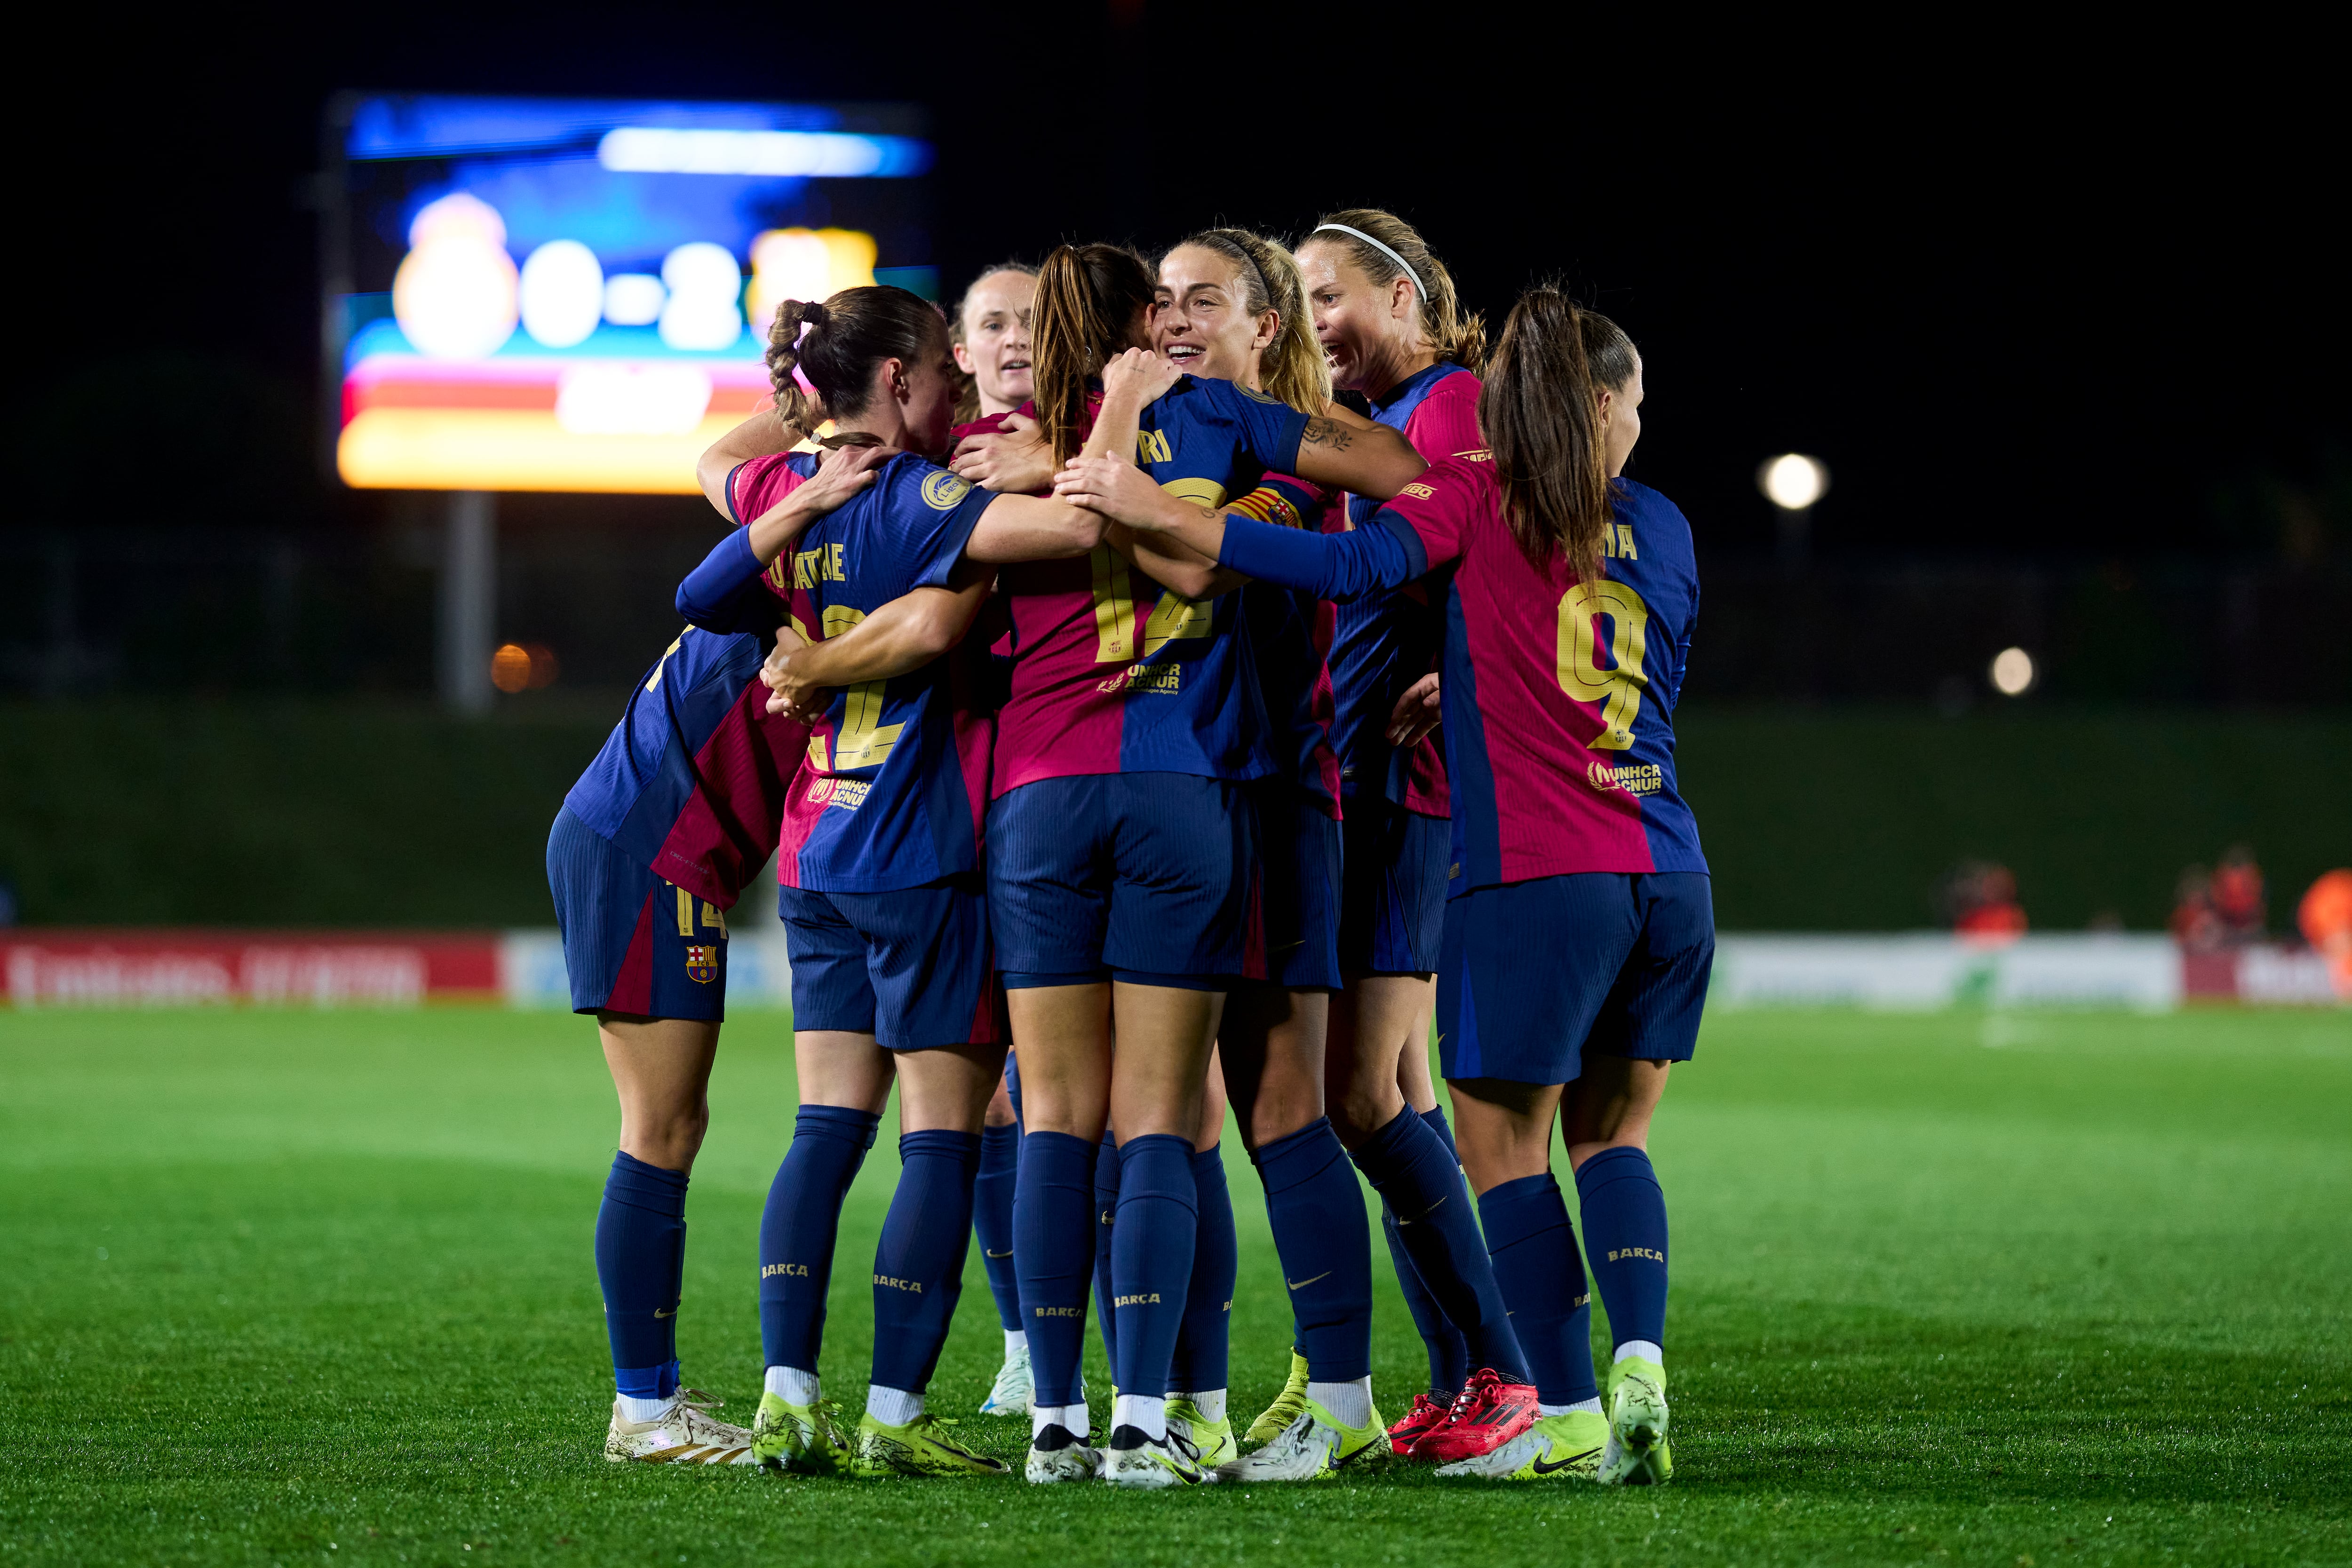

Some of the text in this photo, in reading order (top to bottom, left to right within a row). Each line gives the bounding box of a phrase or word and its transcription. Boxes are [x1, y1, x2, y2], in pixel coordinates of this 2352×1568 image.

[941, 483, 959, 498] Liga
[1127, 664, 1181, 677] UNHCR
[1557, 580, 1649, 750] 9
[1124, 676, 1179, 689] ACNUR
[1608, 764, 1661, 782] UNHCR
[1621, 777, 1661, 792] CNUR
[666, 880, 729, 940] 14
[1608, 1247, 1664, 1263] BARÇA
[762, 1264, 808, 1279] BARÇA
[874, 1274, 922, 1293] BARÇA
